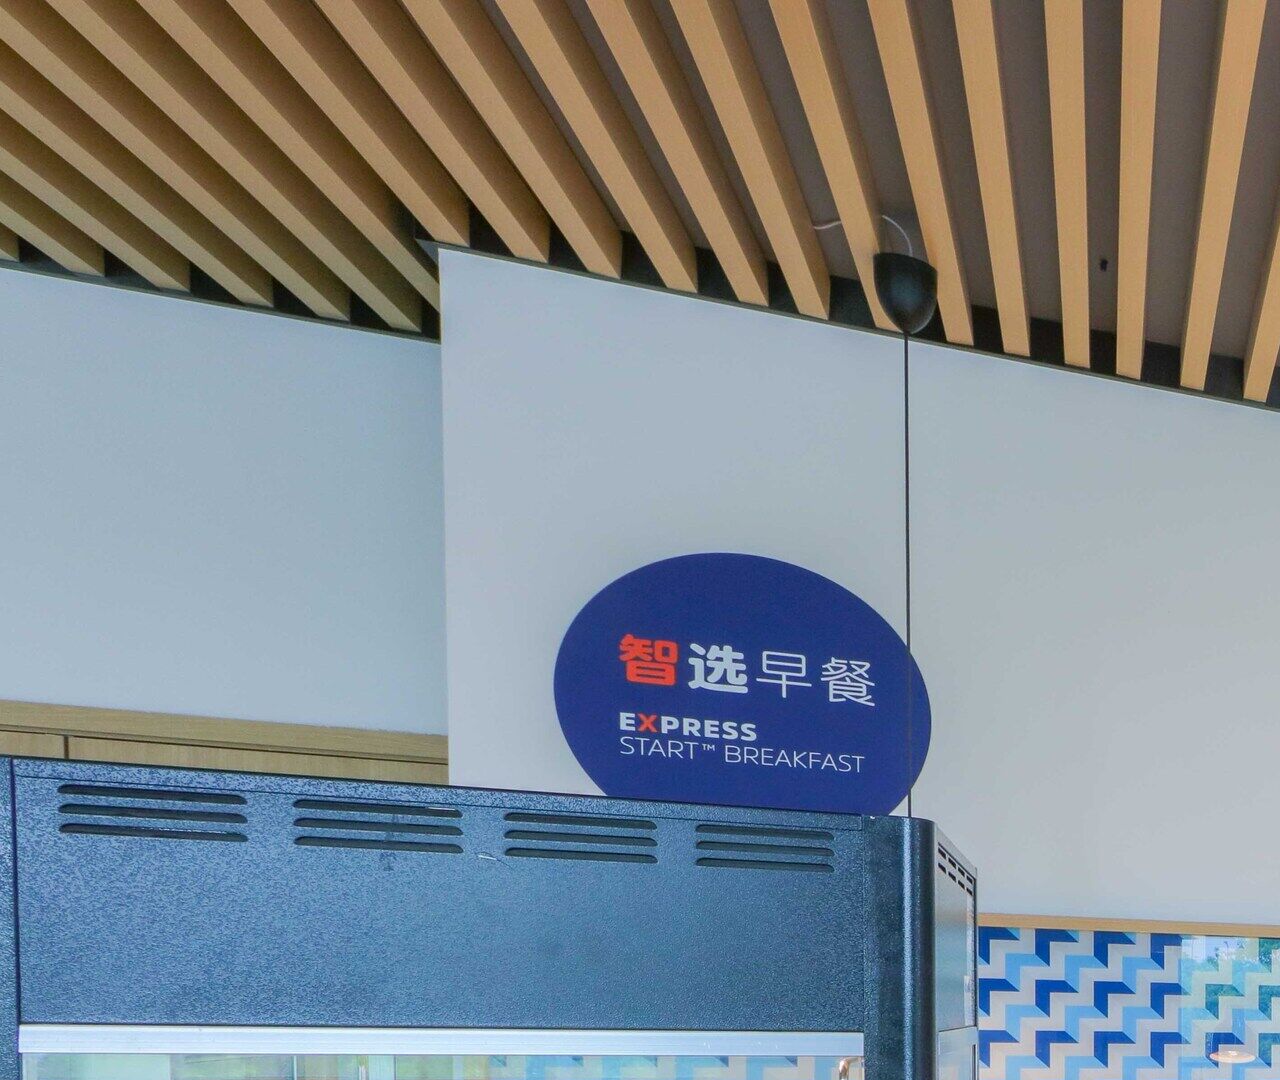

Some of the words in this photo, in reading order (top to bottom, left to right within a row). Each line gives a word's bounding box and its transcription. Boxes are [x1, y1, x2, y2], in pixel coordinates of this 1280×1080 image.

[619, 633, 876, 708] 智选早餐
[619, 712, 757, 741] EXPRESS
[724, 745, 866, 774] BREAKFAST
